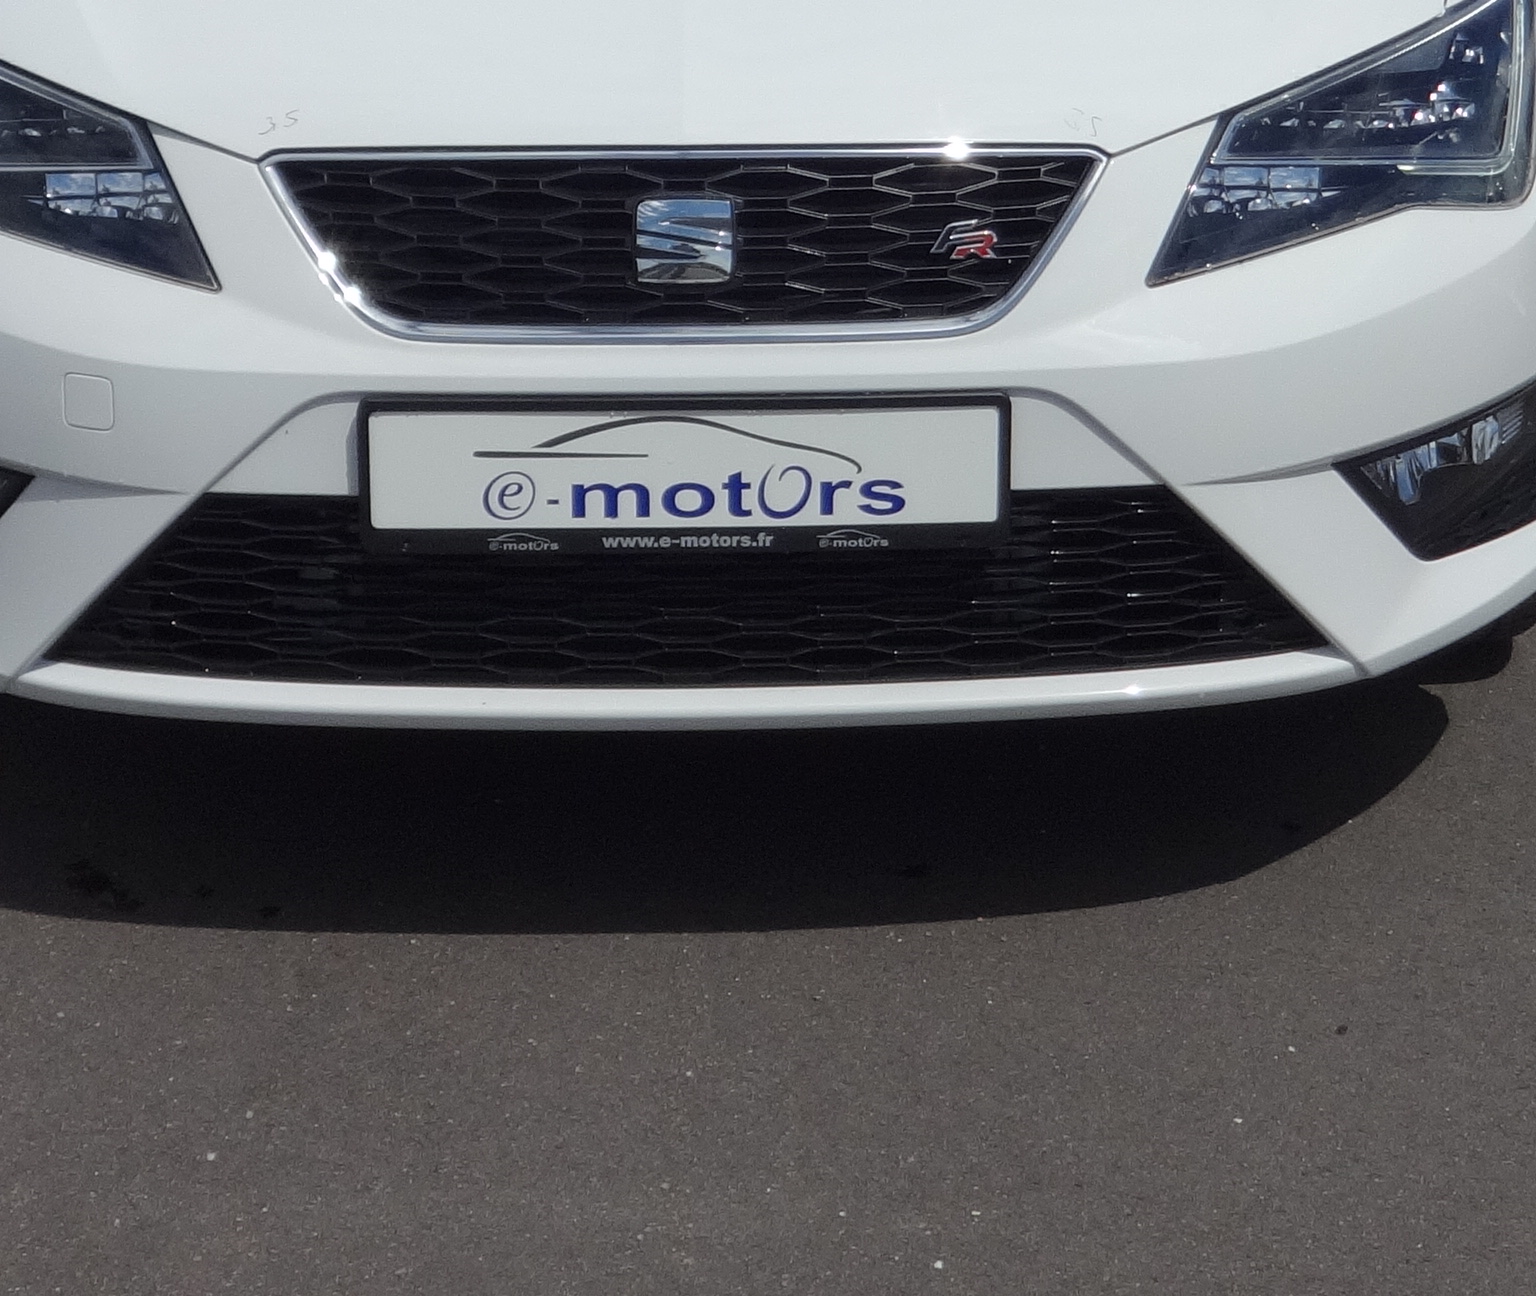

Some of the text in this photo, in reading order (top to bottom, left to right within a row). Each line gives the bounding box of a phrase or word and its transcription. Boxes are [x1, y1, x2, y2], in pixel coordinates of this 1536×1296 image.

[930, 218, 998, 259] FR
[482, 464, 906, 520] e-motors
[601, 532, 774, 550] www.e-motors.fr
